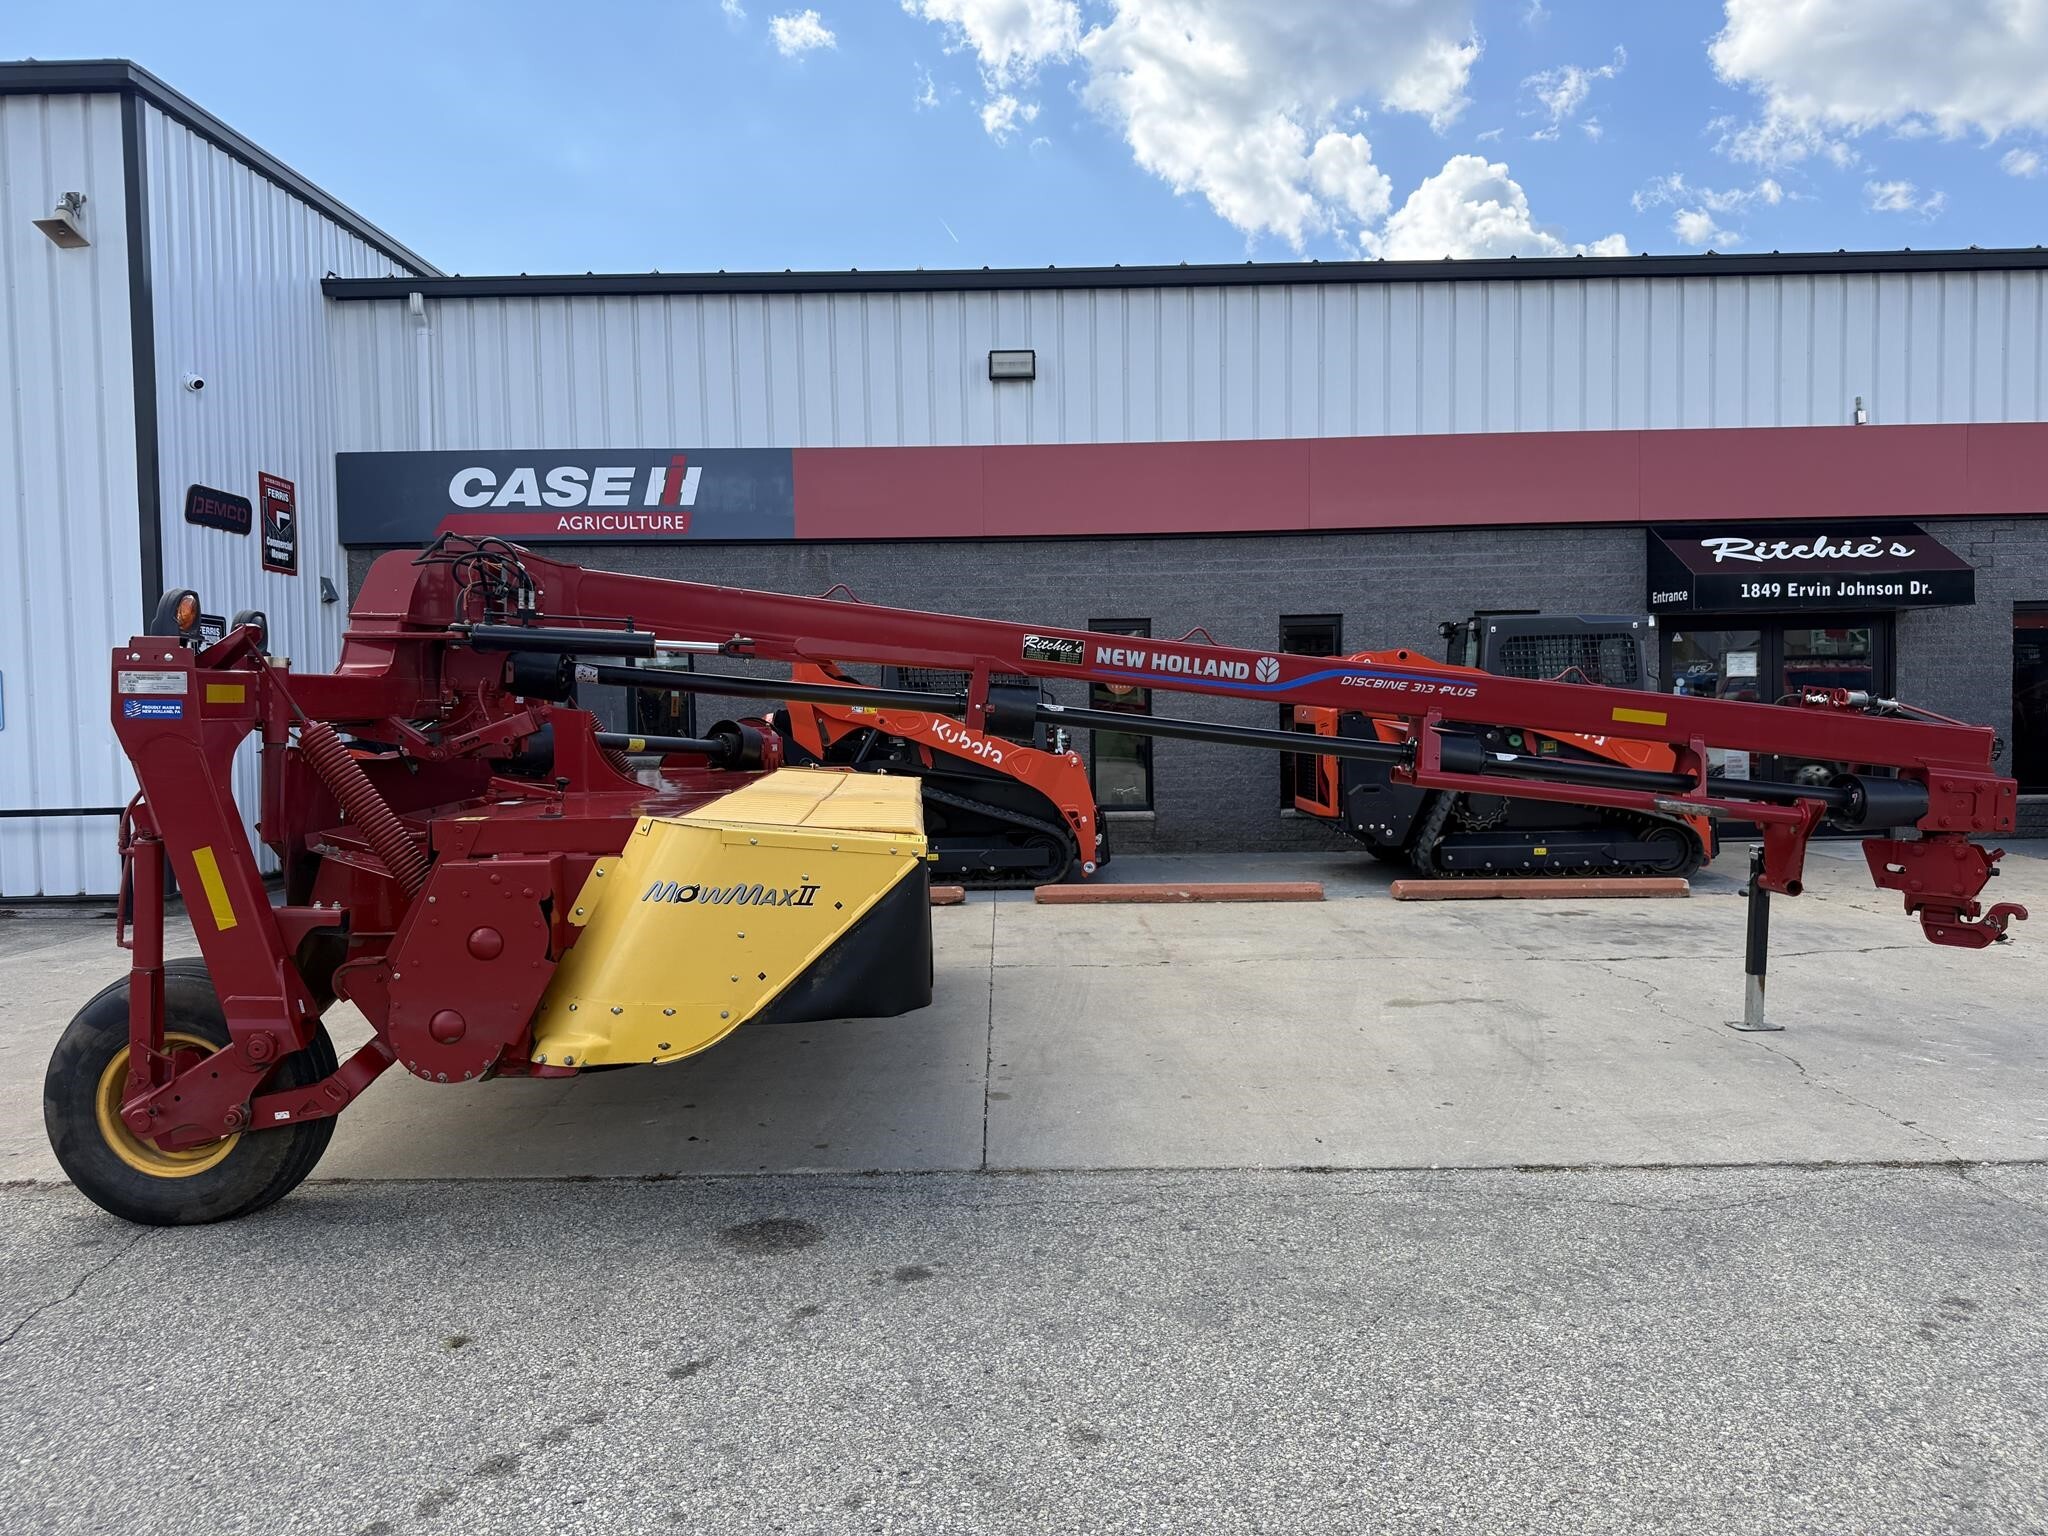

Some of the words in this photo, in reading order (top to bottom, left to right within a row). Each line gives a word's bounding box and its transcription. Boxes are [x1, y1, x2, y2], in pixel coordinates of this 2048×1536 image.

[448, 466, 636, 508] CASE
[643, 454, 702, 506] IH
[267, 488, 289, 502] FERRIS
[192, 496, 247, 523] DEMCO
[557, 515, 684, 530] AGRICULTURE
[267, 536, 293, 551] Commercial
[1701, 535, 1915, 562] Ritchie's
[271, 548, 289, 561] Mowers
[1652, 589, 1688, 604] Entrance
[1741, 583, 1781, 598] 1849
[1788, 582, 1831, 597] Ervin
[1837, 581, 1903, 597] Johnson
[1910, 580, 1933, 595] Dr.
[1024, 636, 1083, 653] Ritchie's
[1096, 646, 1146, 669] NEW
[1151, 652, 1250, 680] HOLLAND
[1688, 665, 1707, 673] AFS
[1341, 676, 1409, 691] DISCBINE
[1411, 683, 1436, 694] 313
[931, 719, 1003, 764] Kubota
